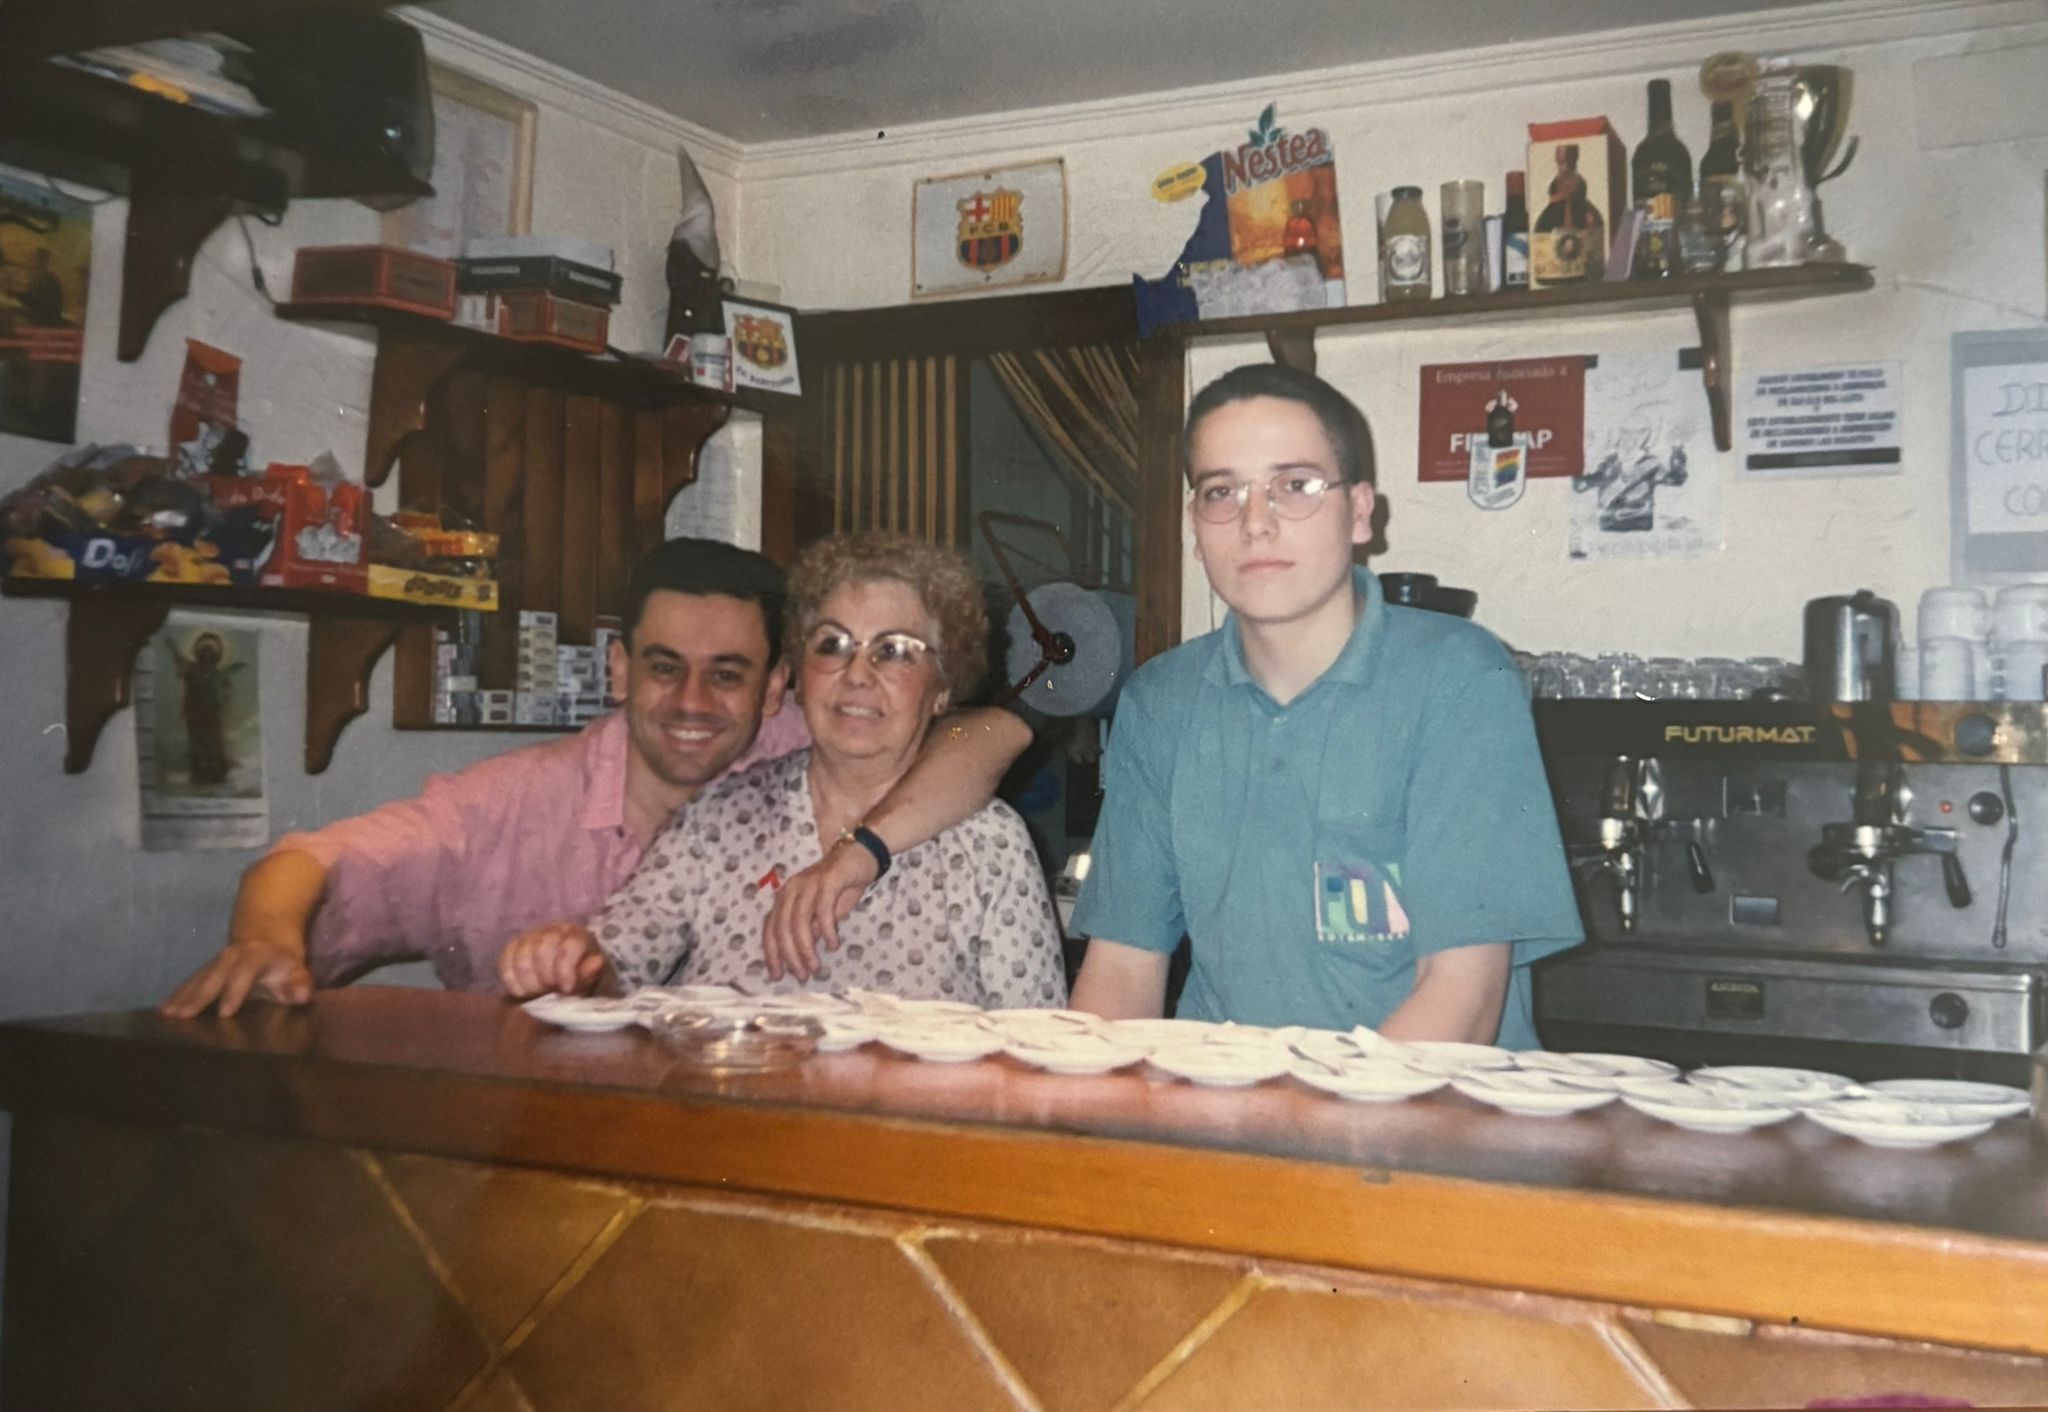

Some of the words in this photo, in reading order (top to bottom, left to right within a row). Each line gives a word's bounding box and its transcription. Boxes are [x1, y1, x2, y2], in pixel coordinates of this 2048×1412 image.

[1222, 127, 1328, 194] Nestea
[1435, 369, 1491, 385] Empresa
[1663, 725, 1817, 743] FUTURMAT
